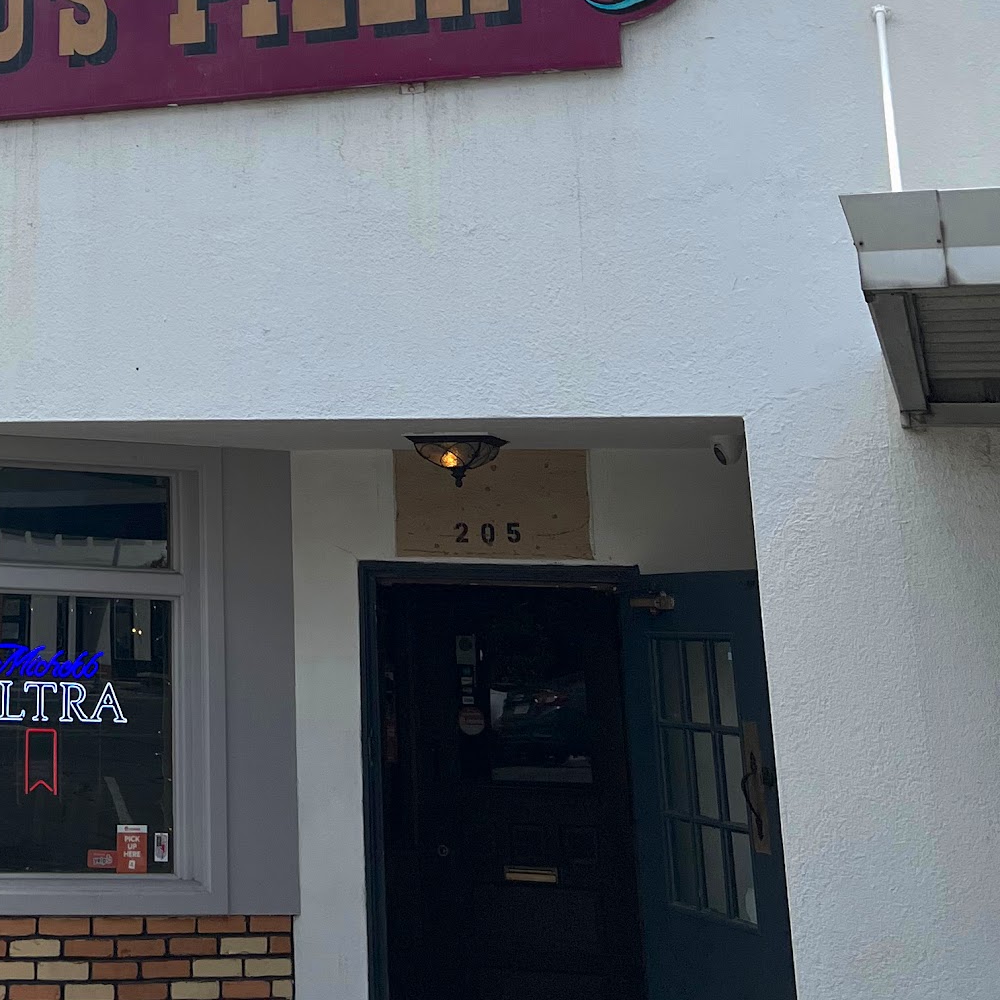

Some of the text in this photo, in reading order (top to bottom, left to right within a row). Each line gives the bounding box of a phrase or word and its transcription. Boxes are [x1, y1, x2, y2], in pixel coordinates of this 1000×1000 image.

[454, 522, 521, 544] 205
[124, 835, 141, 843] PICK
[123, 850, 141, 858] HERE
